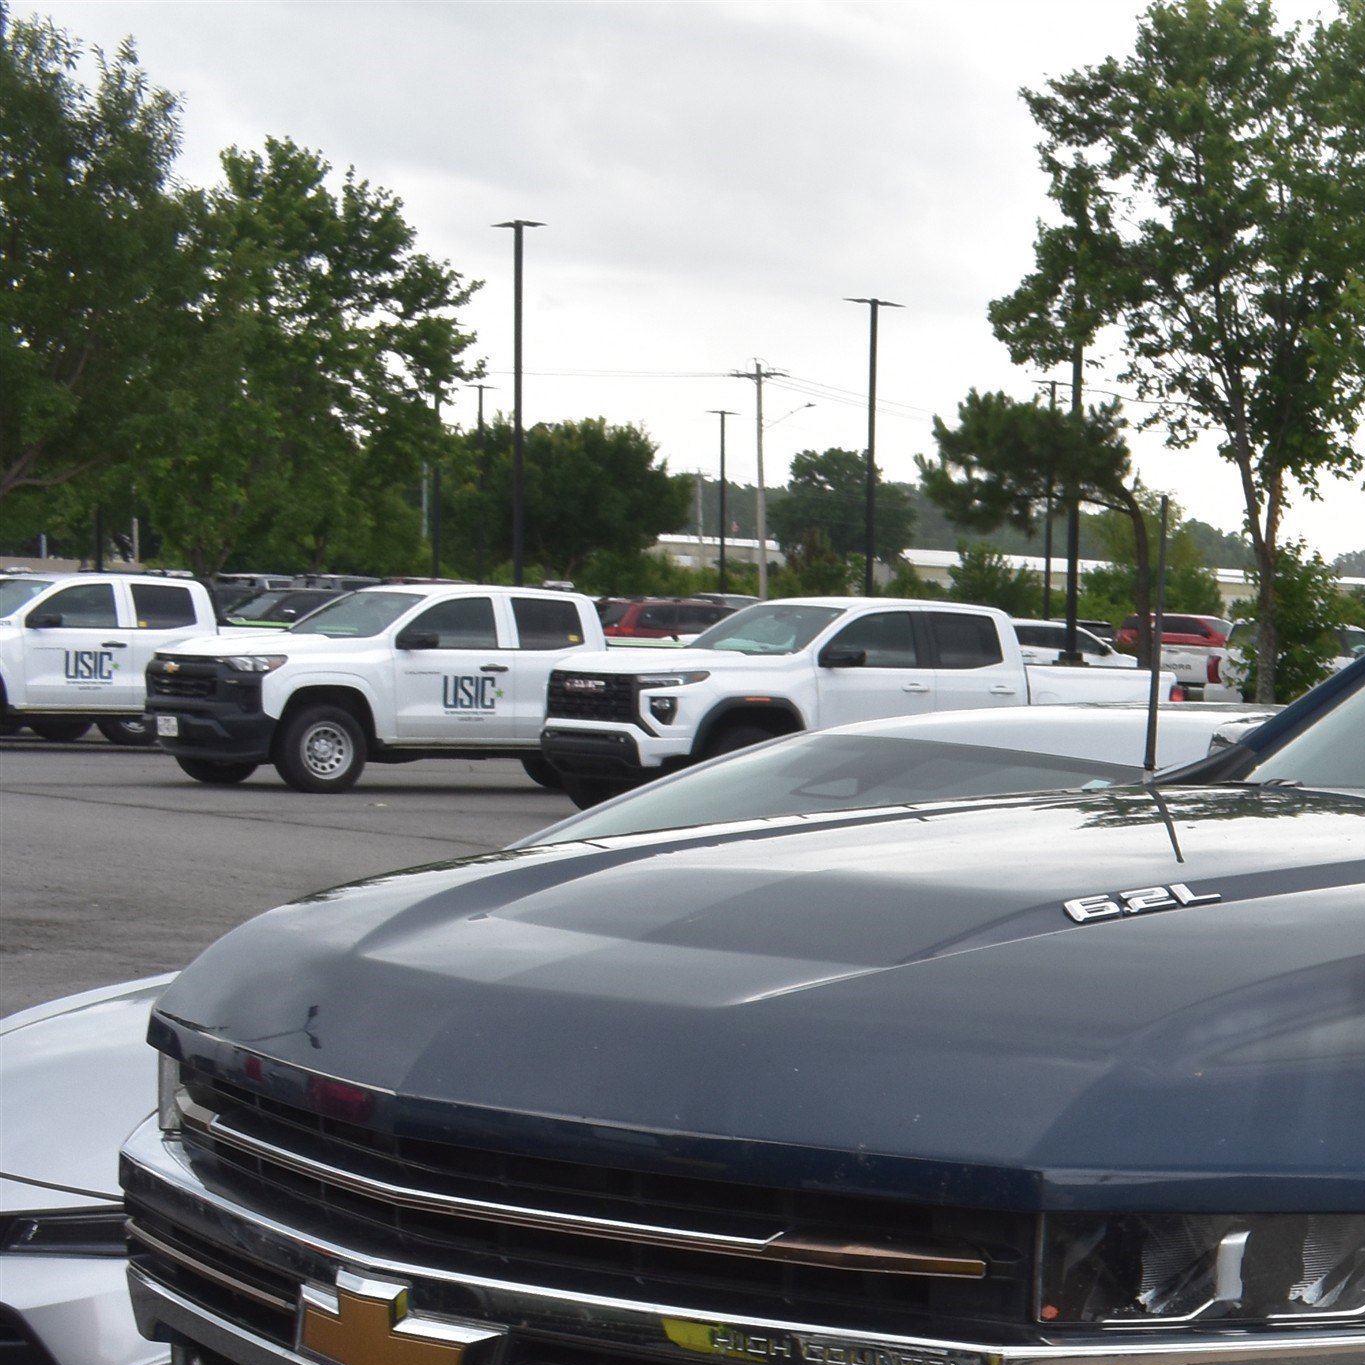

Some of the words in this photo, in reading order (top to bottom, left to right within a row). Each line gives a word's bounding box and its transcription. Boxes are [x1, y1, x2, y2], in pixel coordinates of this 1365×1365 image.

[65, 651, 112, 679] USIC
[443, 675, 495, 709] USIC
[713, 1329, 791, 1358] HIGH
